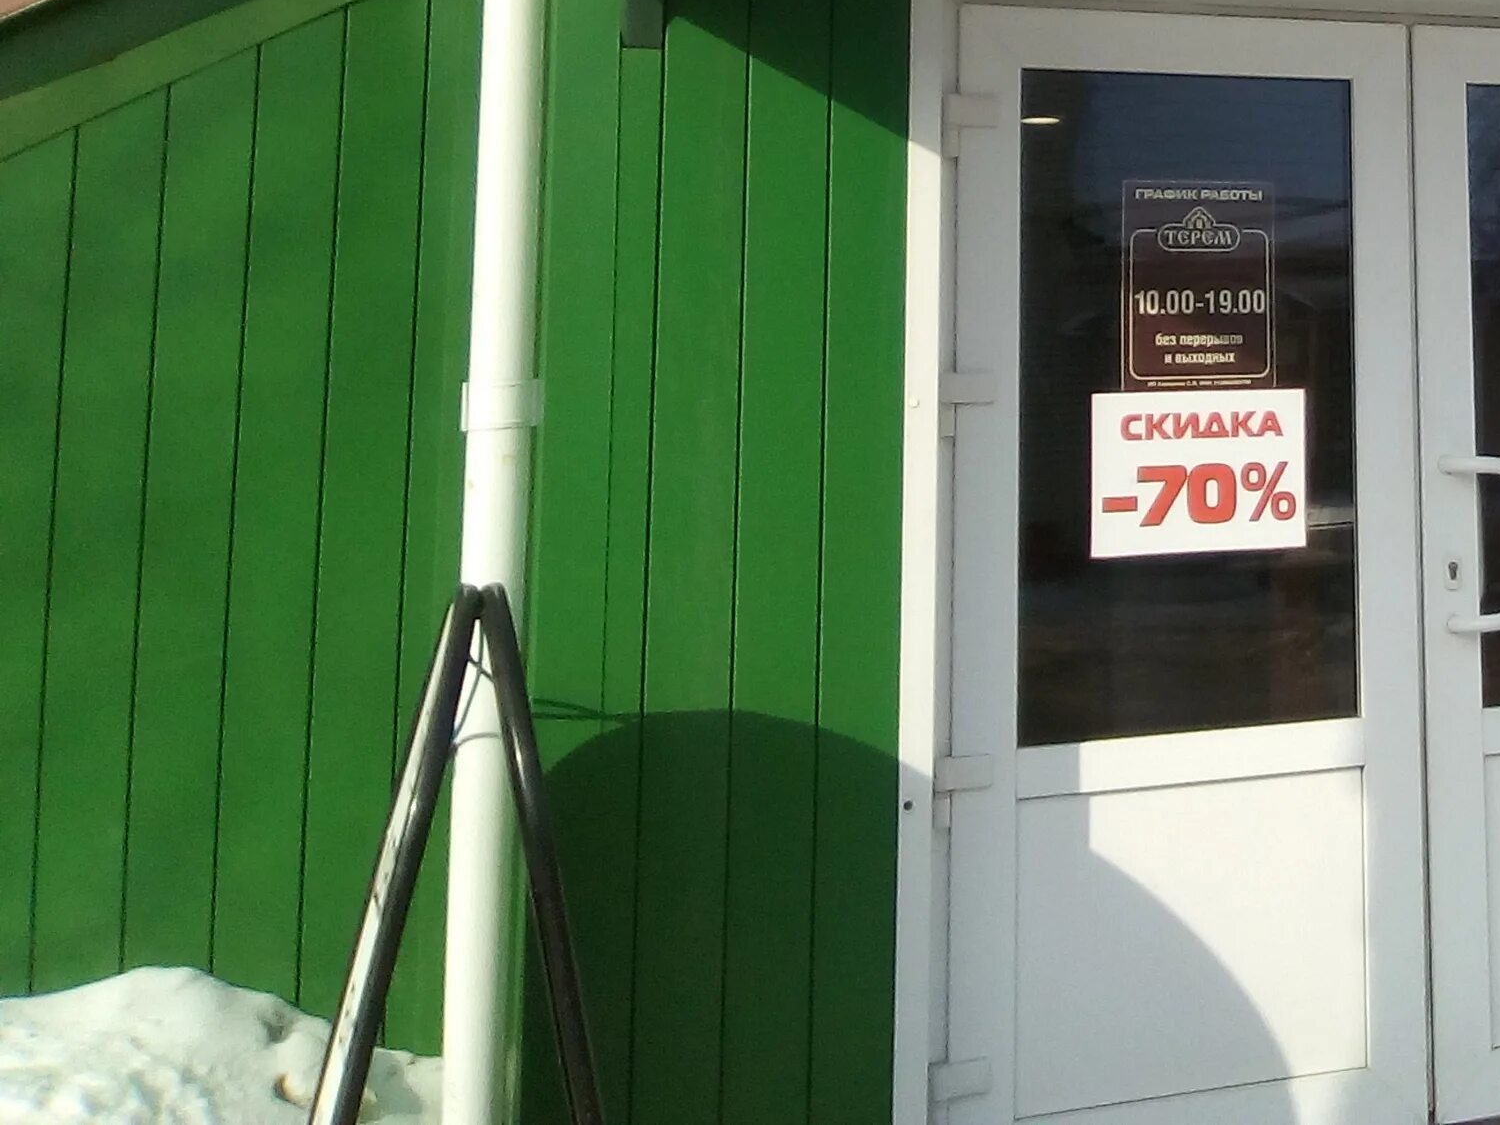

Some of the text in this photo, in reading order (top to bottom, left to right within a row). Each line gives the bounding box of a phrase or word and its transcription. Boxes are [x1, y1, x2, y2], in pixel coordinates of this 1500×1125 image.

[1135, 188, 1263, 202] ГРАФИК РАБОТЫ
[1134, 289, 1266, 315] 10.00-19.00
[1119, 410, 1284, 442] СКИДКА
[1101, 460, 1298, 528] -70%
